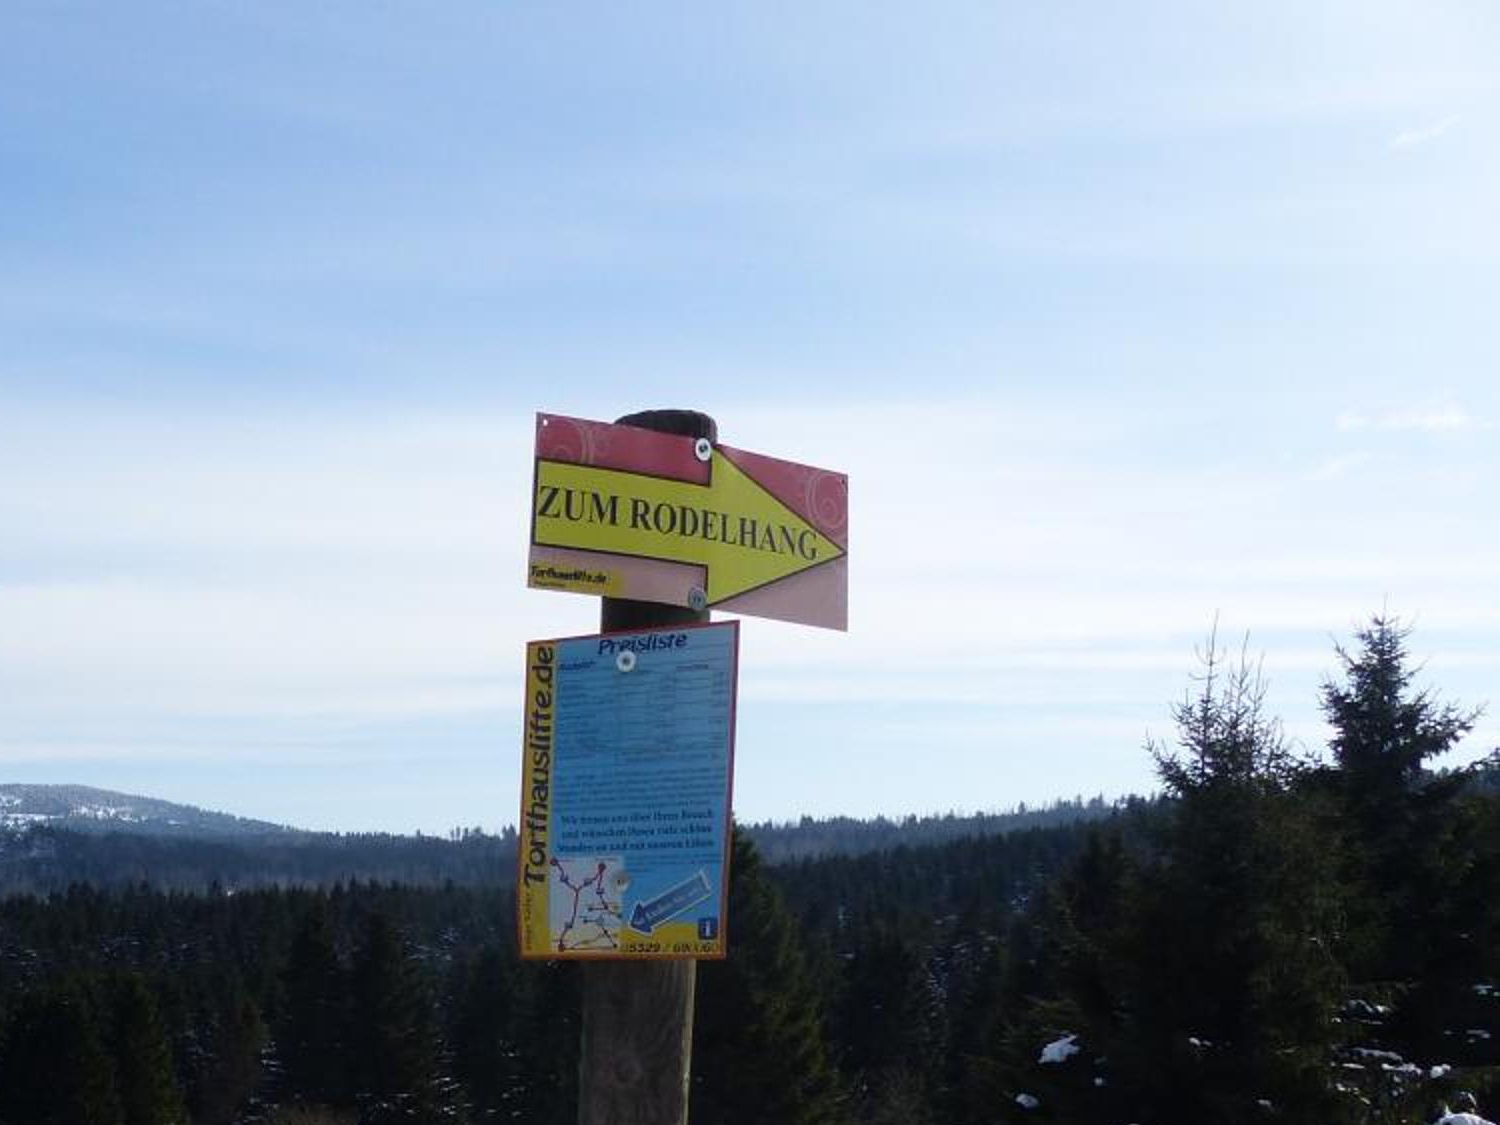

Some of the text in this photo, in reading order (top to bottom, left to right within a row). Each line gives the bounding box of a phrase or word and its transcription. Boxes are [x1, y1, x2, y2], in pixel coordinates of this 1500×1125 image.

[538, 485, 819, 561] ZUM RODELHANG
[598, 633, 688, 654] Preisliste
[524, 645, 554, 888] Torfhauslifte.de
